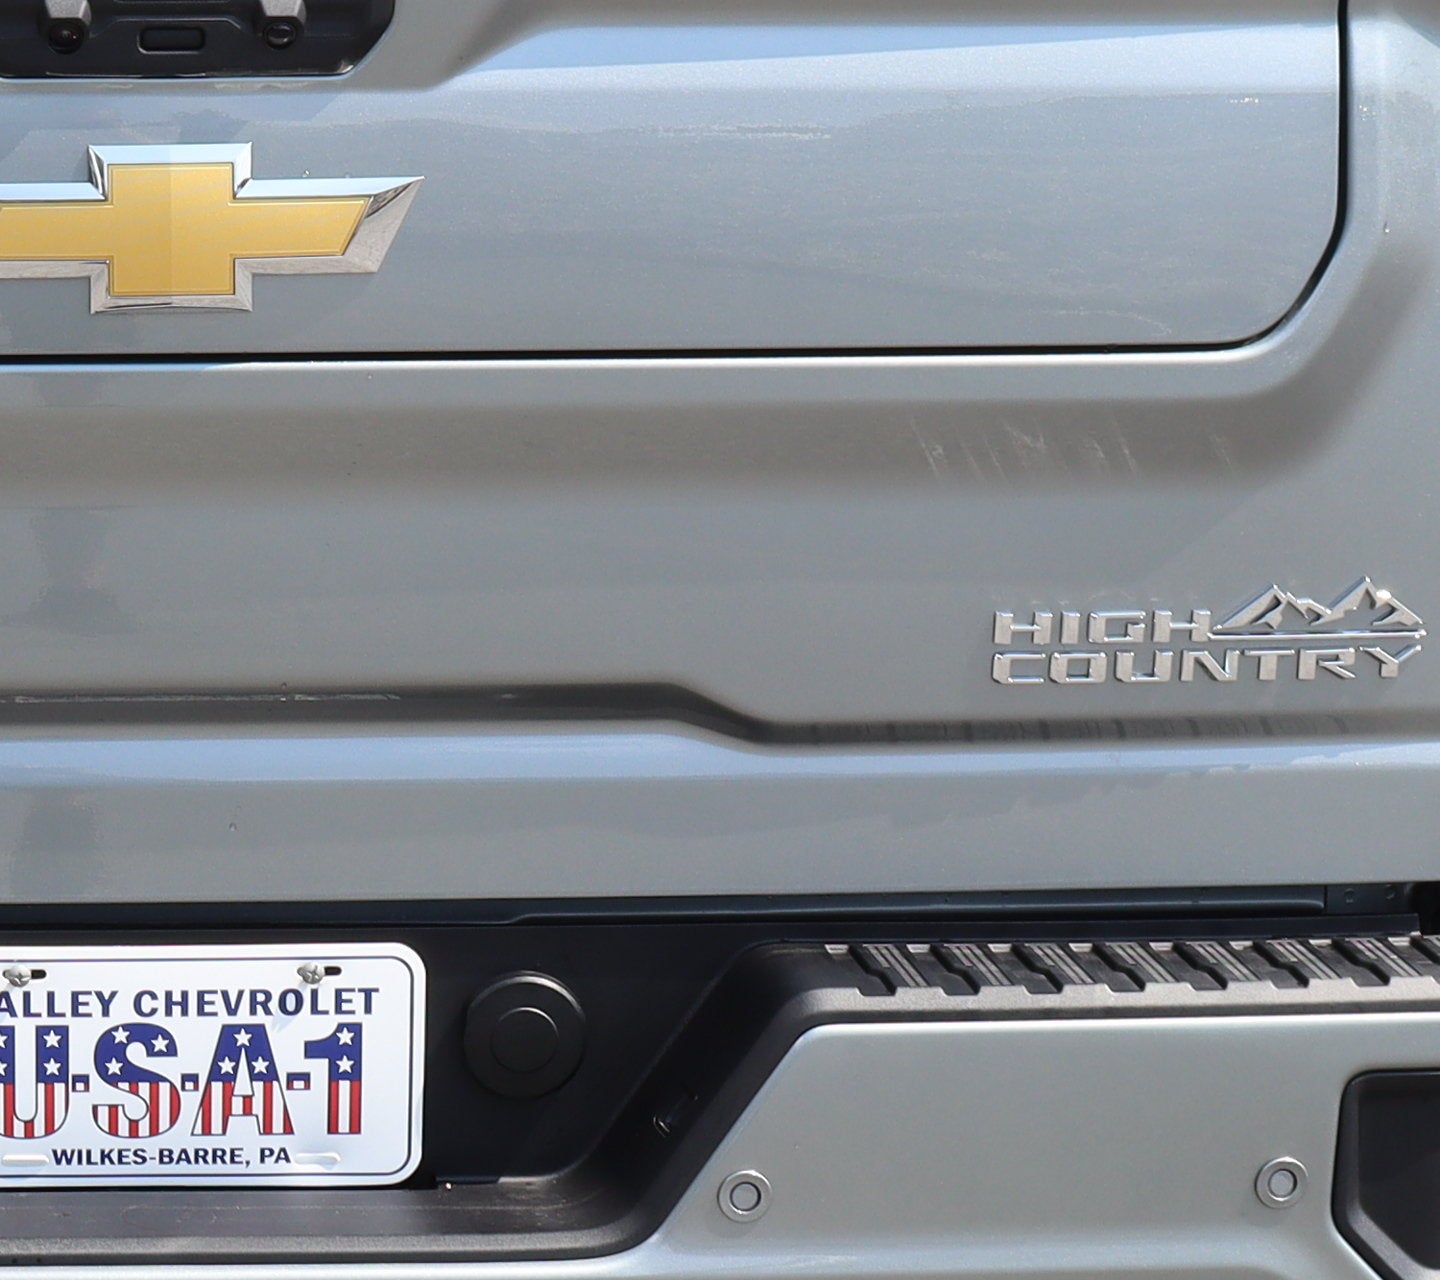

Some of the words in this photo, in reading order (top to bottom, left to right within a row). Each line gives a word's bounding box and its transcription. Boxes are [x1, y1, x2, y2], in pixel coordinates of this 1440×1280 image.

[993, 609, 1213, 644] HIGH
[992, 644, 1422, 684] COUNTRY
[132, 987, 380, 1017] CHEVROLET
[51, 1147, 251, 1168] WILKES-BARRE,
[259, 1148, 291, 1165] PA
